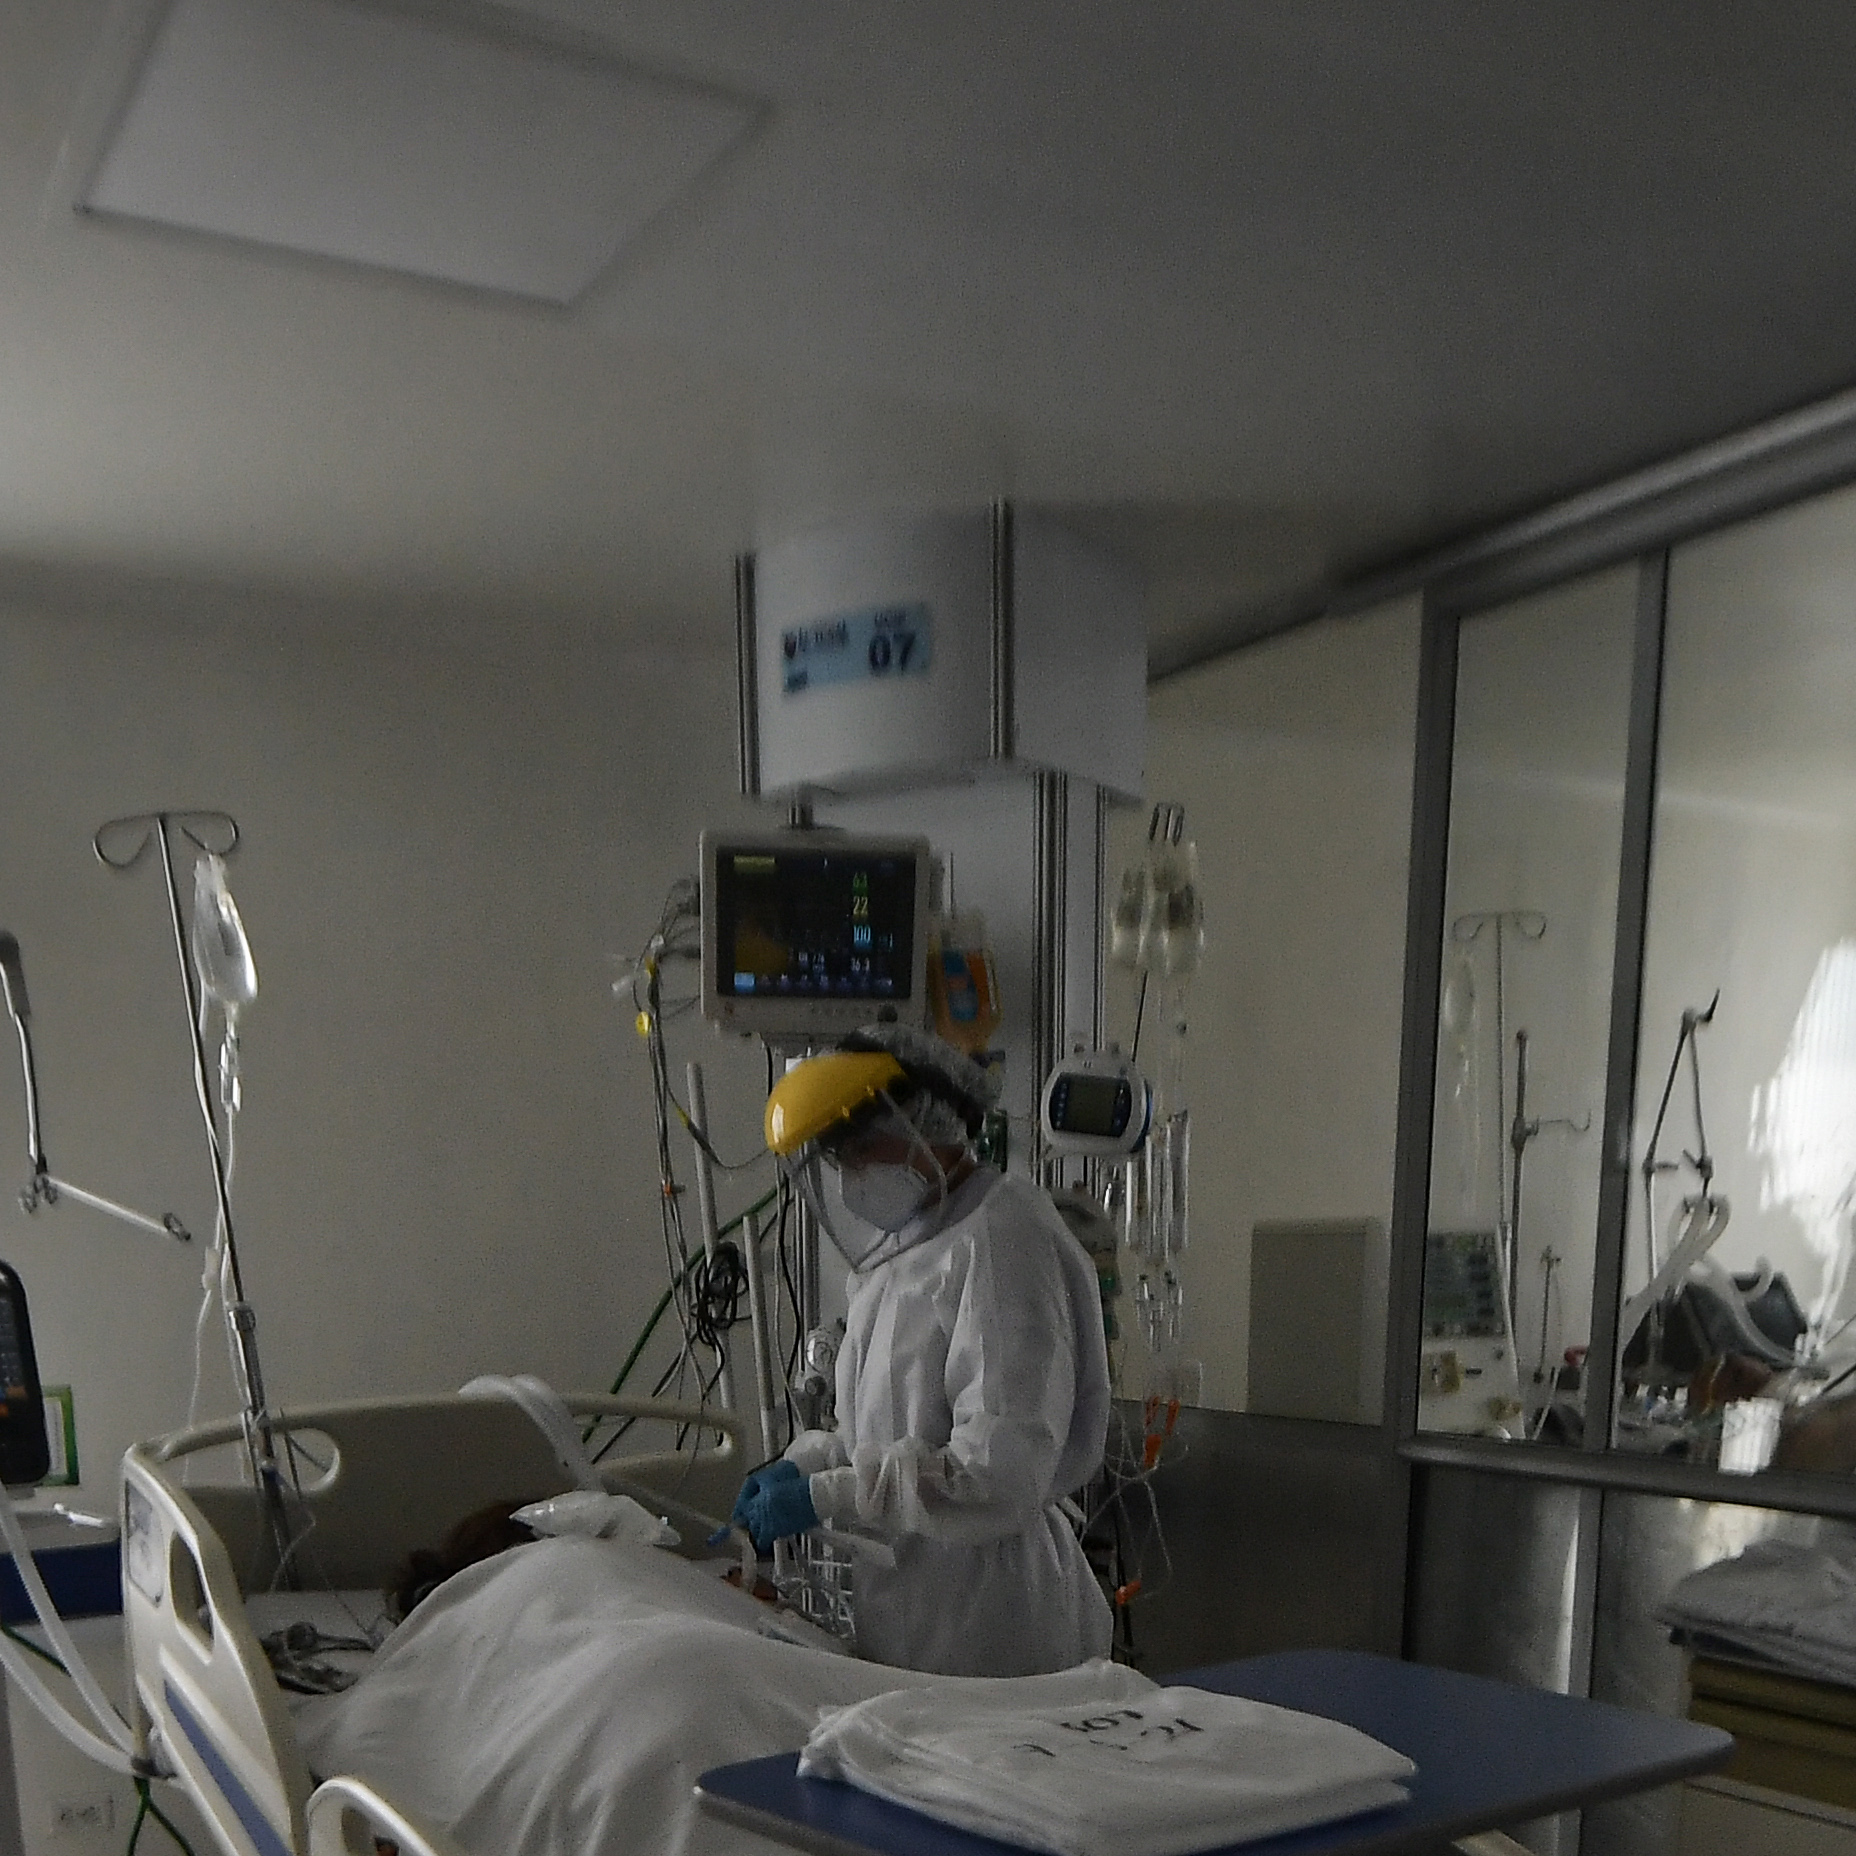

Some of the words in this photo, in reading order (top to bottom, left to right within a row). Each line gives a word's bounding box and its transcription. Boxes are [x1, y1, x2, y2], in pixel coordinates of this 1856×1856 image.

[868, 631, 917, 676] 07
[852, 896, 869, 915] 22
[853, 925, 871, 944] 100
